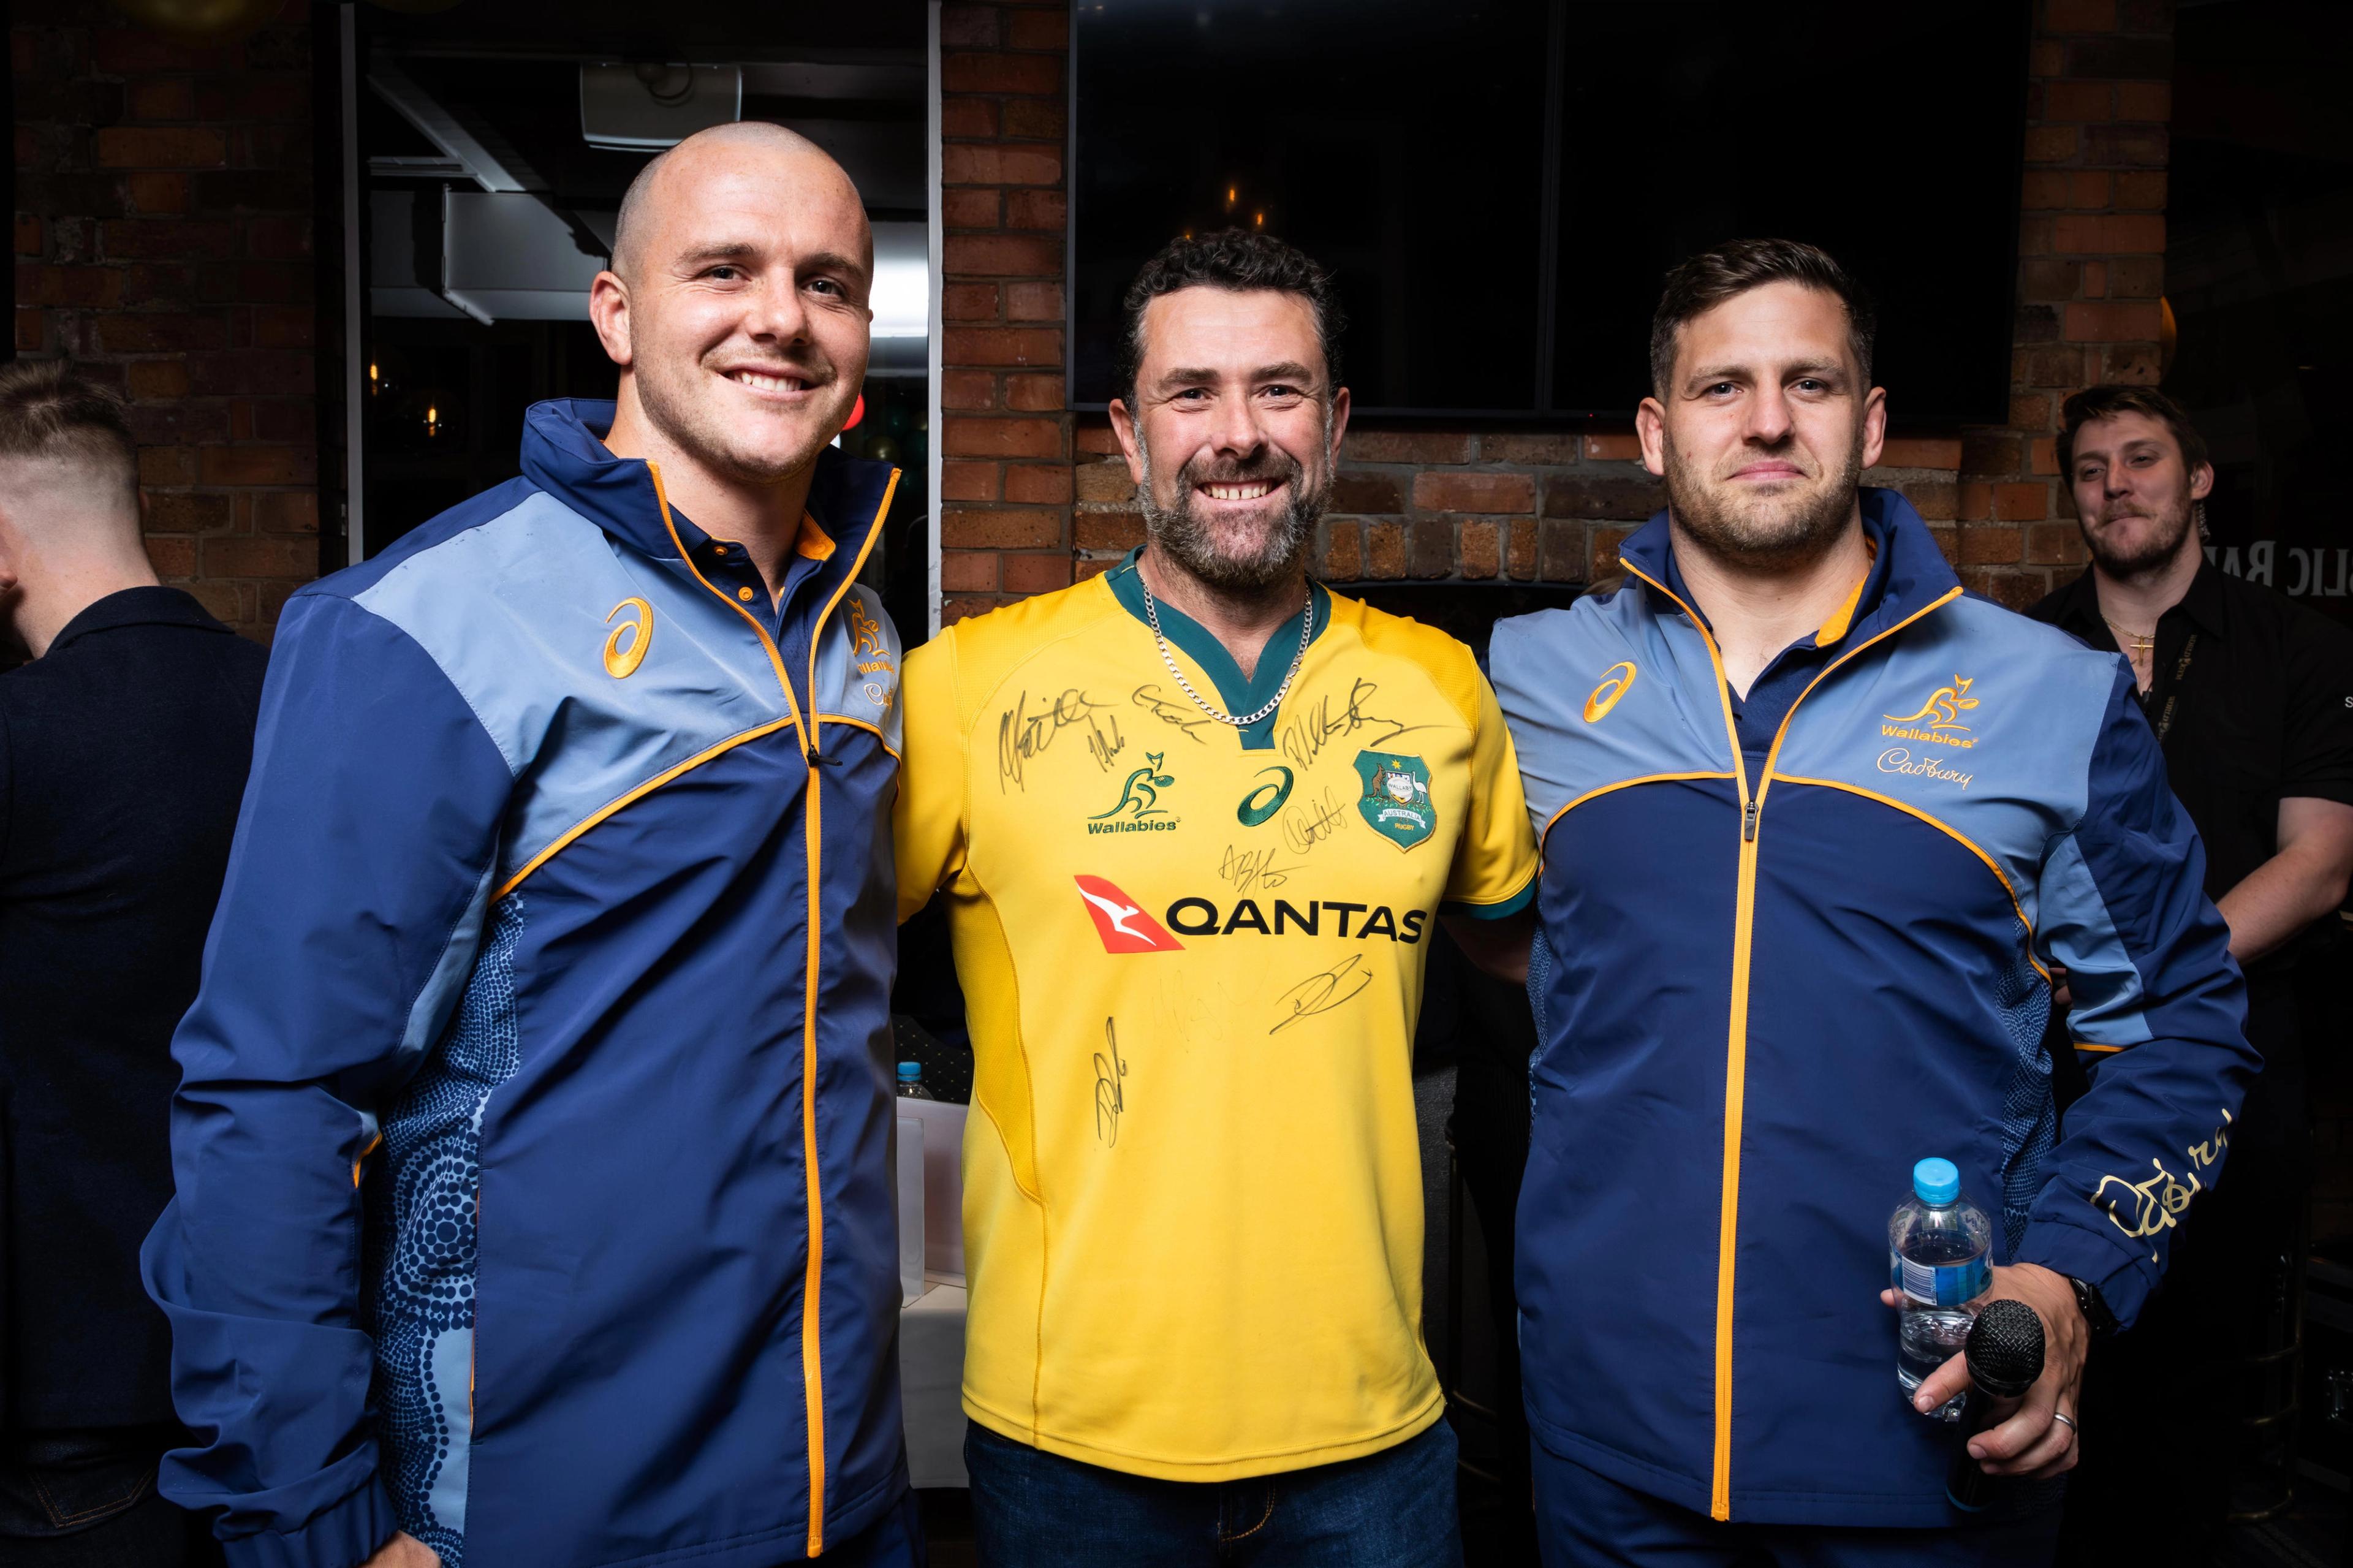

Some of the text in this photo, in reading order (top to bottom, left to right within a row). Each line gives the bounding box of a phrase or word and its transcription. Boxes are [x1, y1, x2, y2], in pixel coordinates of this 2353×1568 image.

[1881, 724, 1973, 748] Wallabies
[1876, 748, 1974, 790] Cadbury
[1384, 809, 1420, 821] AUSTRALIA
[1088, 820, 1176, 835] Wallabies
[1165, 897, 1428, 944] QANTAS
